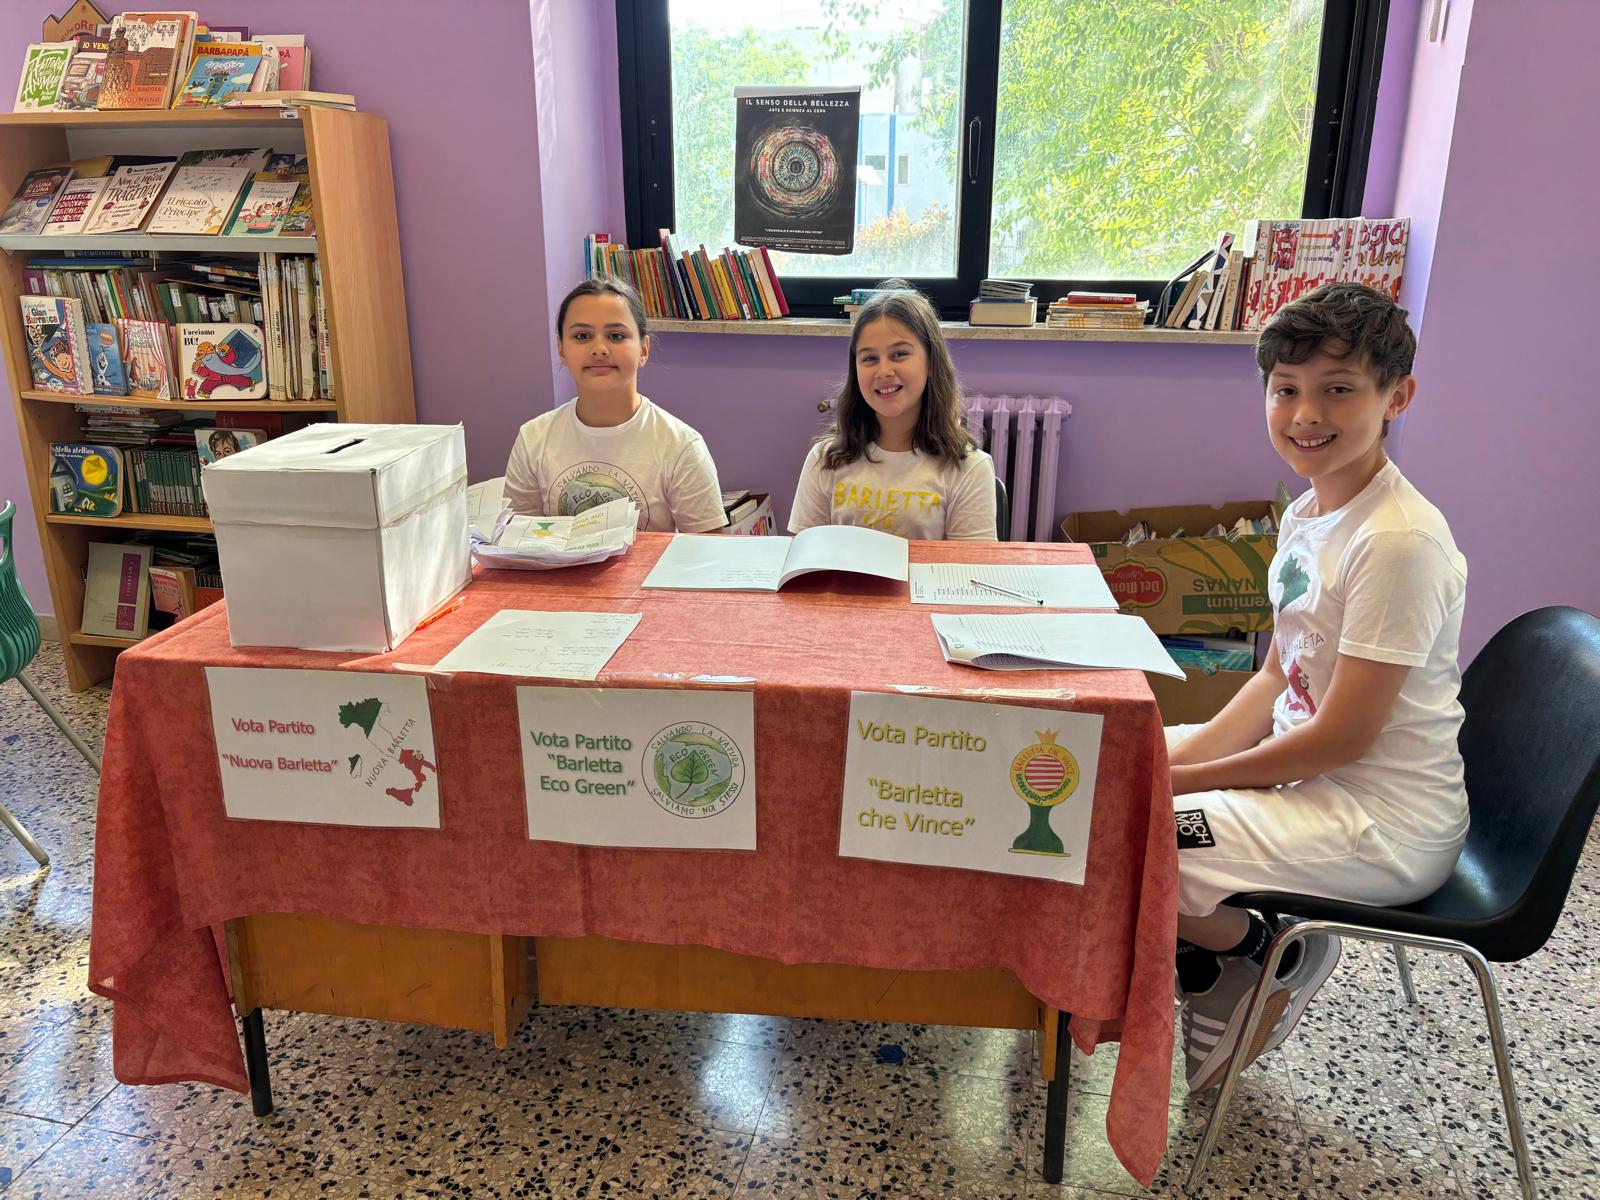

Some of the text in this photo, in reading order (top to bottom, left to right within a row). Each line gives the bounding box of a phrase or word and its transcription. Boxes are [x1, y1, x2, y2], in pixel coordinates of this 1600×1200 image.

[197, 46, 249, 56] BARBAPAPÀ
[745, 98, 753, 106] IL
[755, 98, 781, 106] SENSO
[107, 183, 160, 201] TRAGEDIA!
[26, 315, 58, 324] Burrasca
[31, 307, 47, 316] Gian
[557, 465, 600, 488] SALVANDO
[608, 469, 618, 478] LA
[572, 489, 592, 504] ECO
[834, 481, 943, 514] BARLETTA
[863, 511, 894, 529] CHE
[1111, 580, 1161, 595] Del Mon
[1192, 578, 1257, 594] NANAS
[1206, 596, 1271, 609] remium
[231, 717, 316, 735] Vota Partito
[530, 730, 632, 751] Vota Partito
[856, 718, 987, 753] Vota Partito
[365, 718, 416, 788] NUOVA BARLETTA
[651, 724, 740, 769] SALVANDO LA NATURA
[668, 748, 721, 778] ECO GREEN
[540, 775, 570, 793] Eco
[651, 782, 739, 816] SALVIAMO NOI STESSI
[856, 807, 897, 830] che
[1188, 811, 1212, 845] RICH
